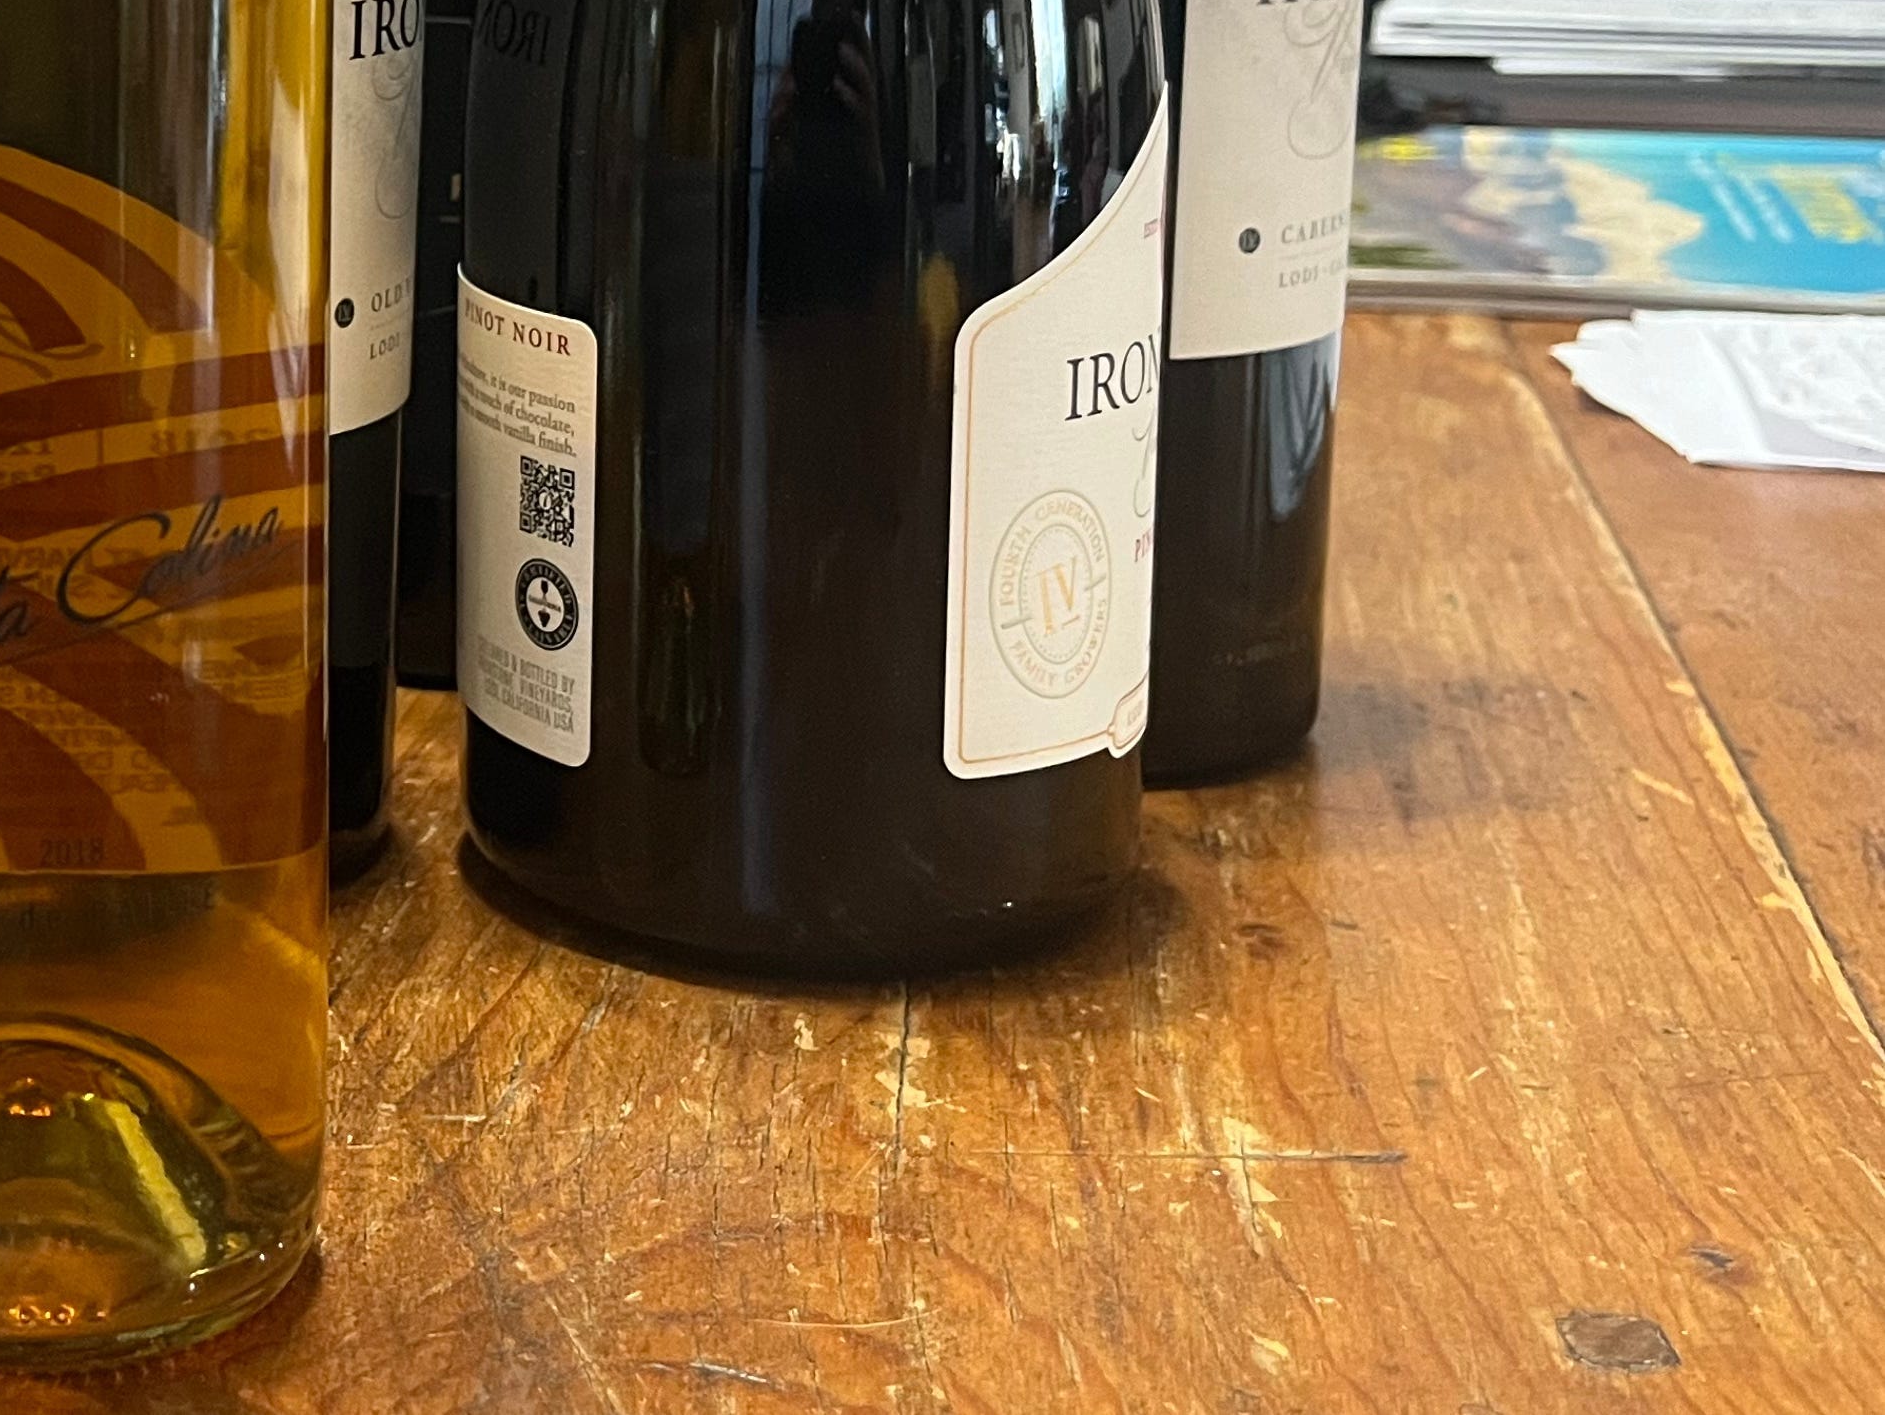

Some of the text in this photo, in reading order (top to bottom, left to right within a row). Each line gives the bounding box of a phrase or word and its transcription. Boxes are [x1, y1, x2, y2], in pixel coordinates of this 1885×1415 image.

[465, 298, 571, 356] PINOT NOIR
[529, 390, 576, 414] passion
[515, 405, 575, 437] chocolate,
[538, 431, 577, 458] finish.
[57, 493, 282, 627] Colina
[999, 496, 1104, 607] FOURTH GENERATION
[1031, 554, 1080, 636] IV
[1009, 598, 1107, 687] FAMILY GROWERS
[561, 670, 576, 696] BY
[553, 711, 575, 735] USA
[39, 835, 105, 866] 2018
